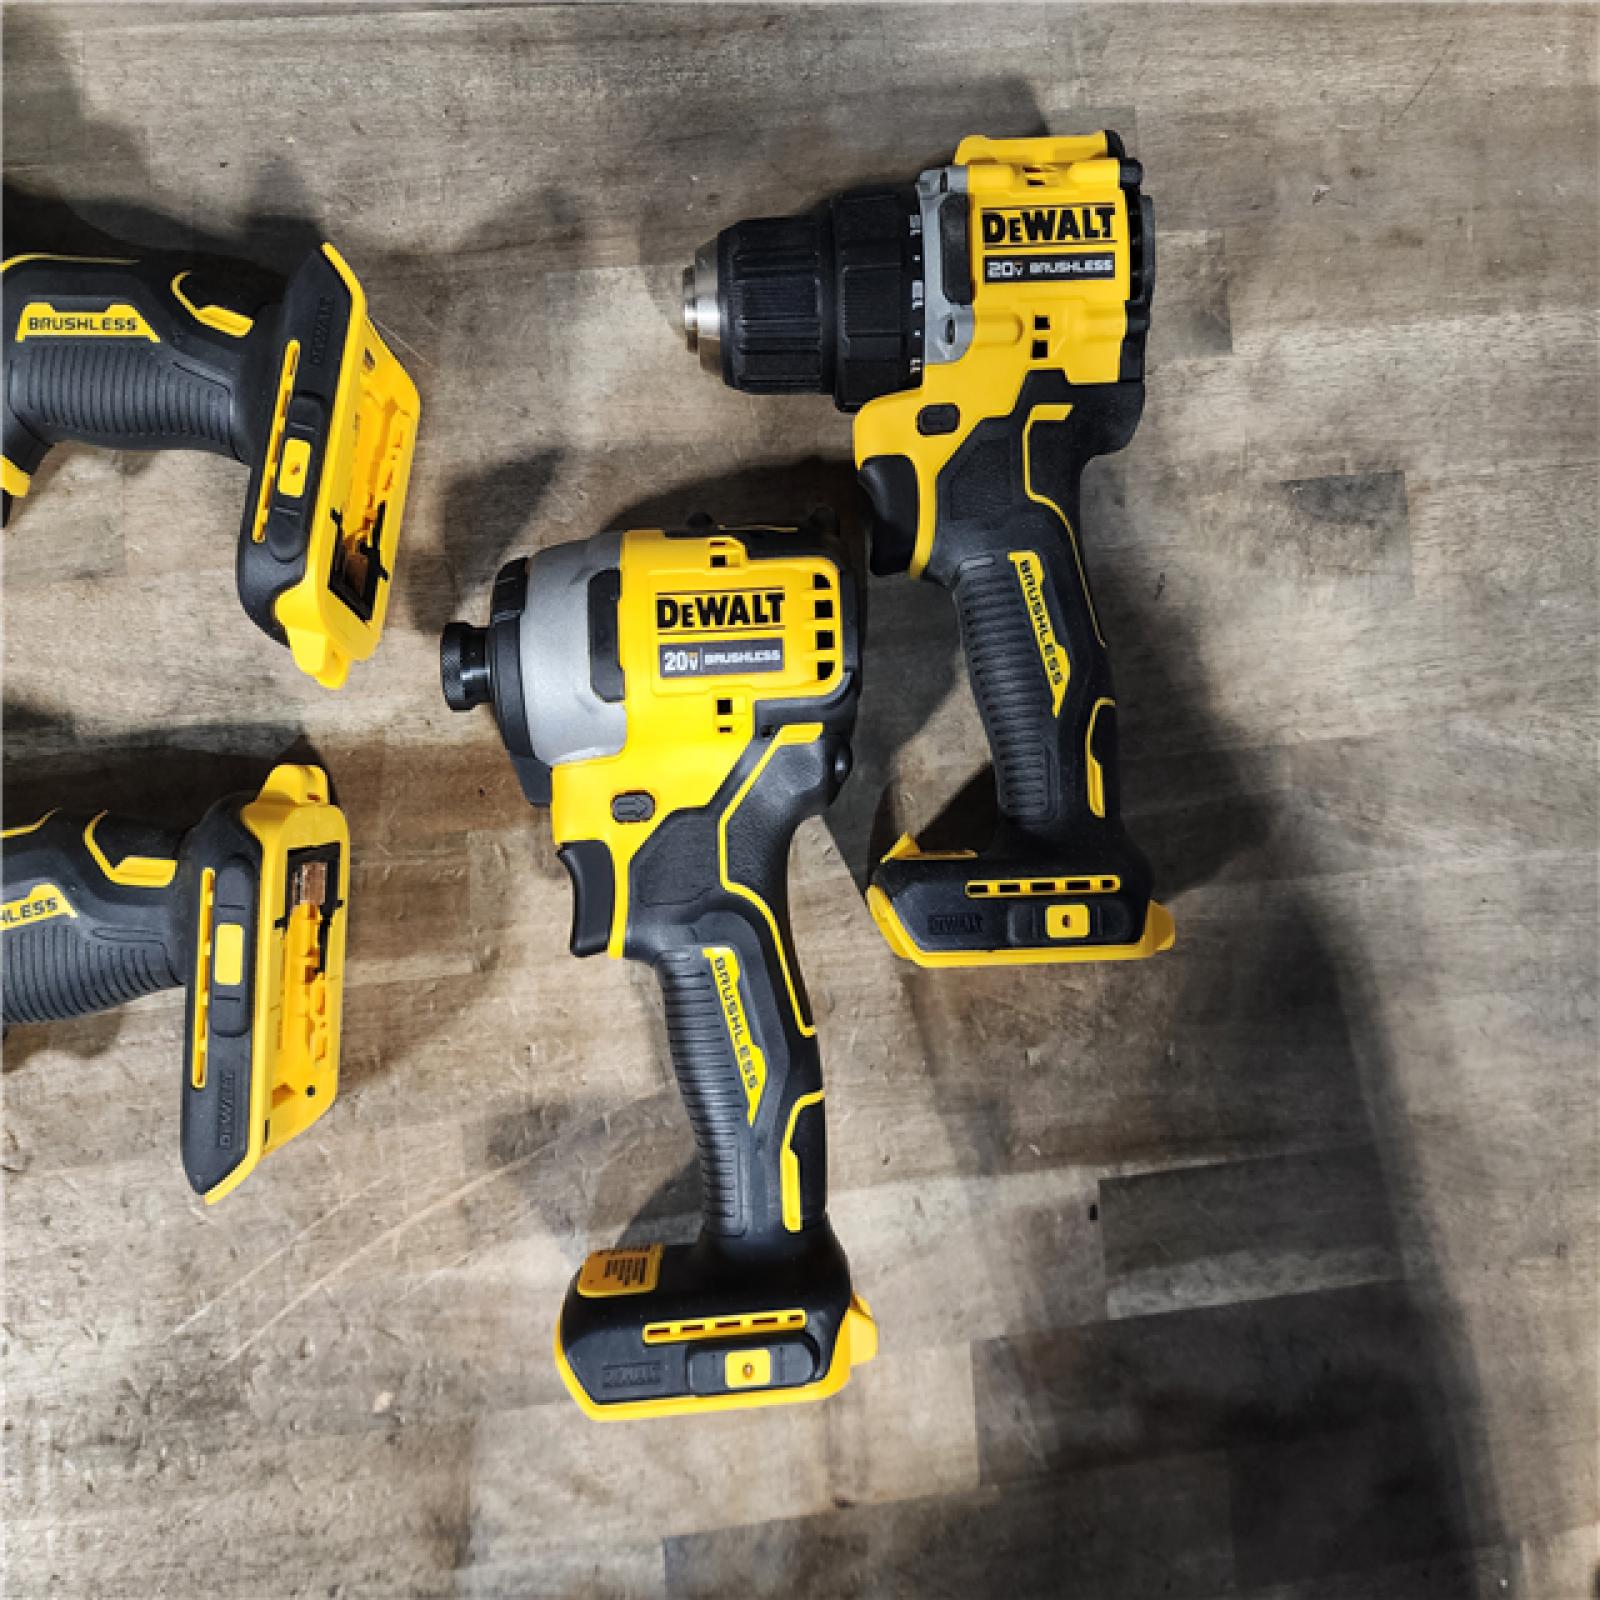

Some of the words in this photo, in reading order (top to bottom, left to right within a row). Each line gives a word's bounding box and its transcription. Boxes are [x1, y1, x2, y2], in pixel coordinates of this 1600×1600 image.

[1029, 259, 1113, 273] BRUSHLESS
[28, 316, 138, 331] BRUSHLESS
[1019, 559, 1062, 686] BRUSHLESS
[704, 649, 781, 665] BRUSHLESS
[714, 957, 758, 1088] BRUSHLESS
